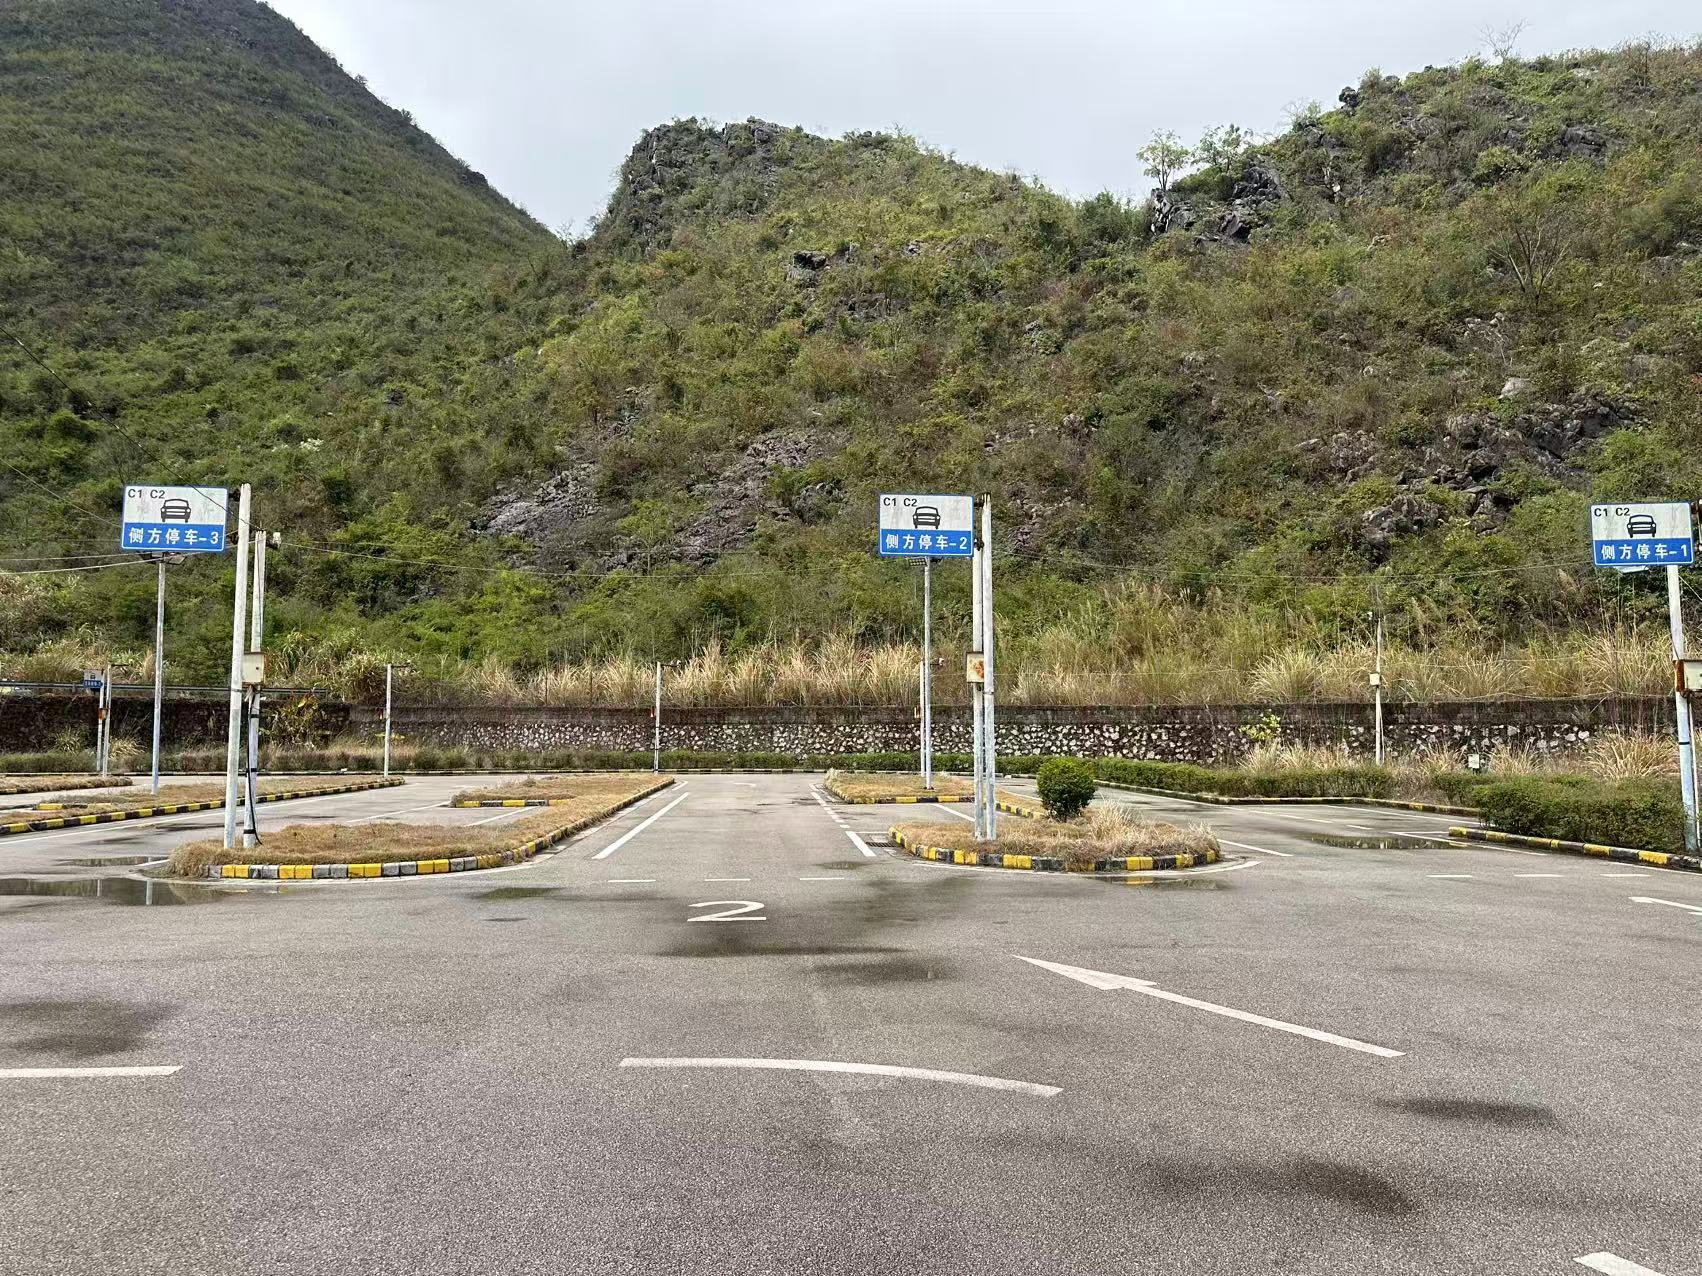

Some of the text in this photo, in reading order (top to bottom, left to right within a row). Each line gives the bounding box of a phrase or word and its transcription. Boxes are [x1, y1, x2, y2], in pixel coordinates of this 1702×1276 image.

[128, 489, 166, 499] C1 C2
[883, 497, 918, 507] C1 C2
[1594, 508, 1631, 517] C1 C2
[129, 527, 219, 545] 侧方停车-3
[886, 534, 968, 550] 侧方停车-2
[1601, 543, 1688, 560] 侧方停车-1
[687, 900, 767, 922] 2
